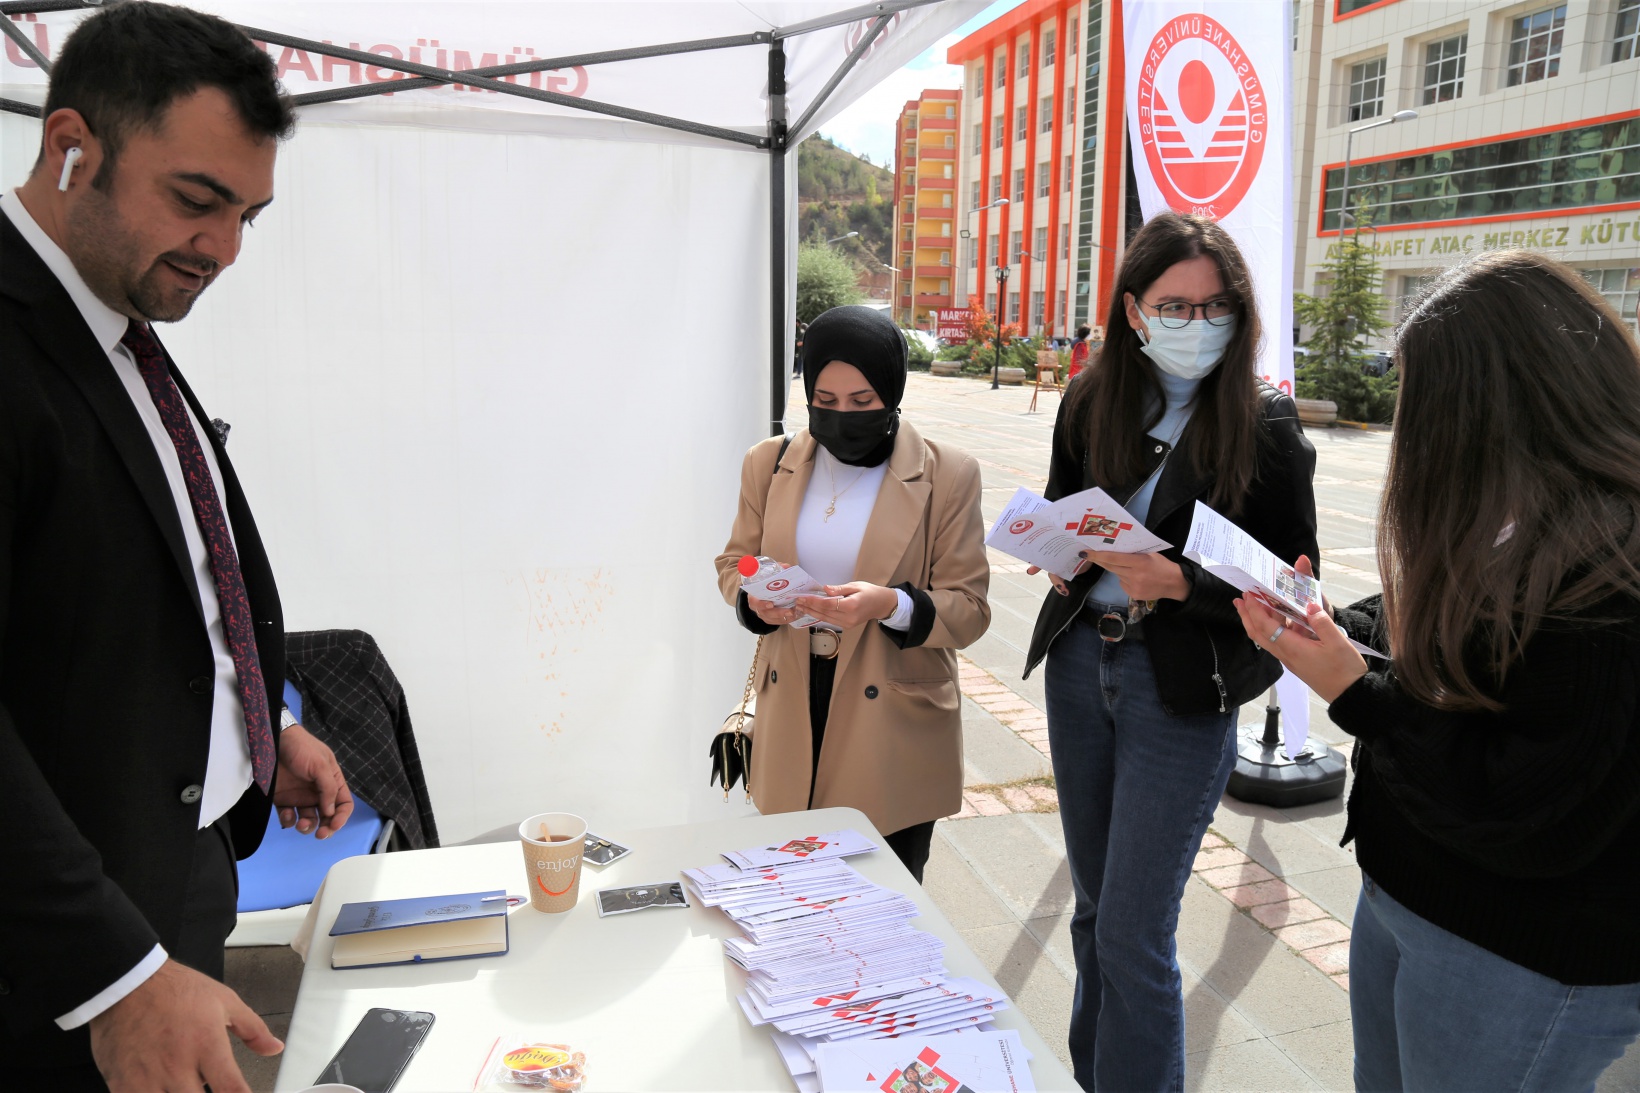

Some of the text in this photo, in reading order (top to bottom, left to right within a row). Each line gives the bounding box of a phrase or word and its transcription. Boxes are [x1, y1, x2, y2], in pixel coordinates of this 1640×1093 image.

[1429, 234, 1475, 255] ATAÇ
[1483, 227, 1570, 250] MERKEZ
[536, 855, 579, 873] enjoy
